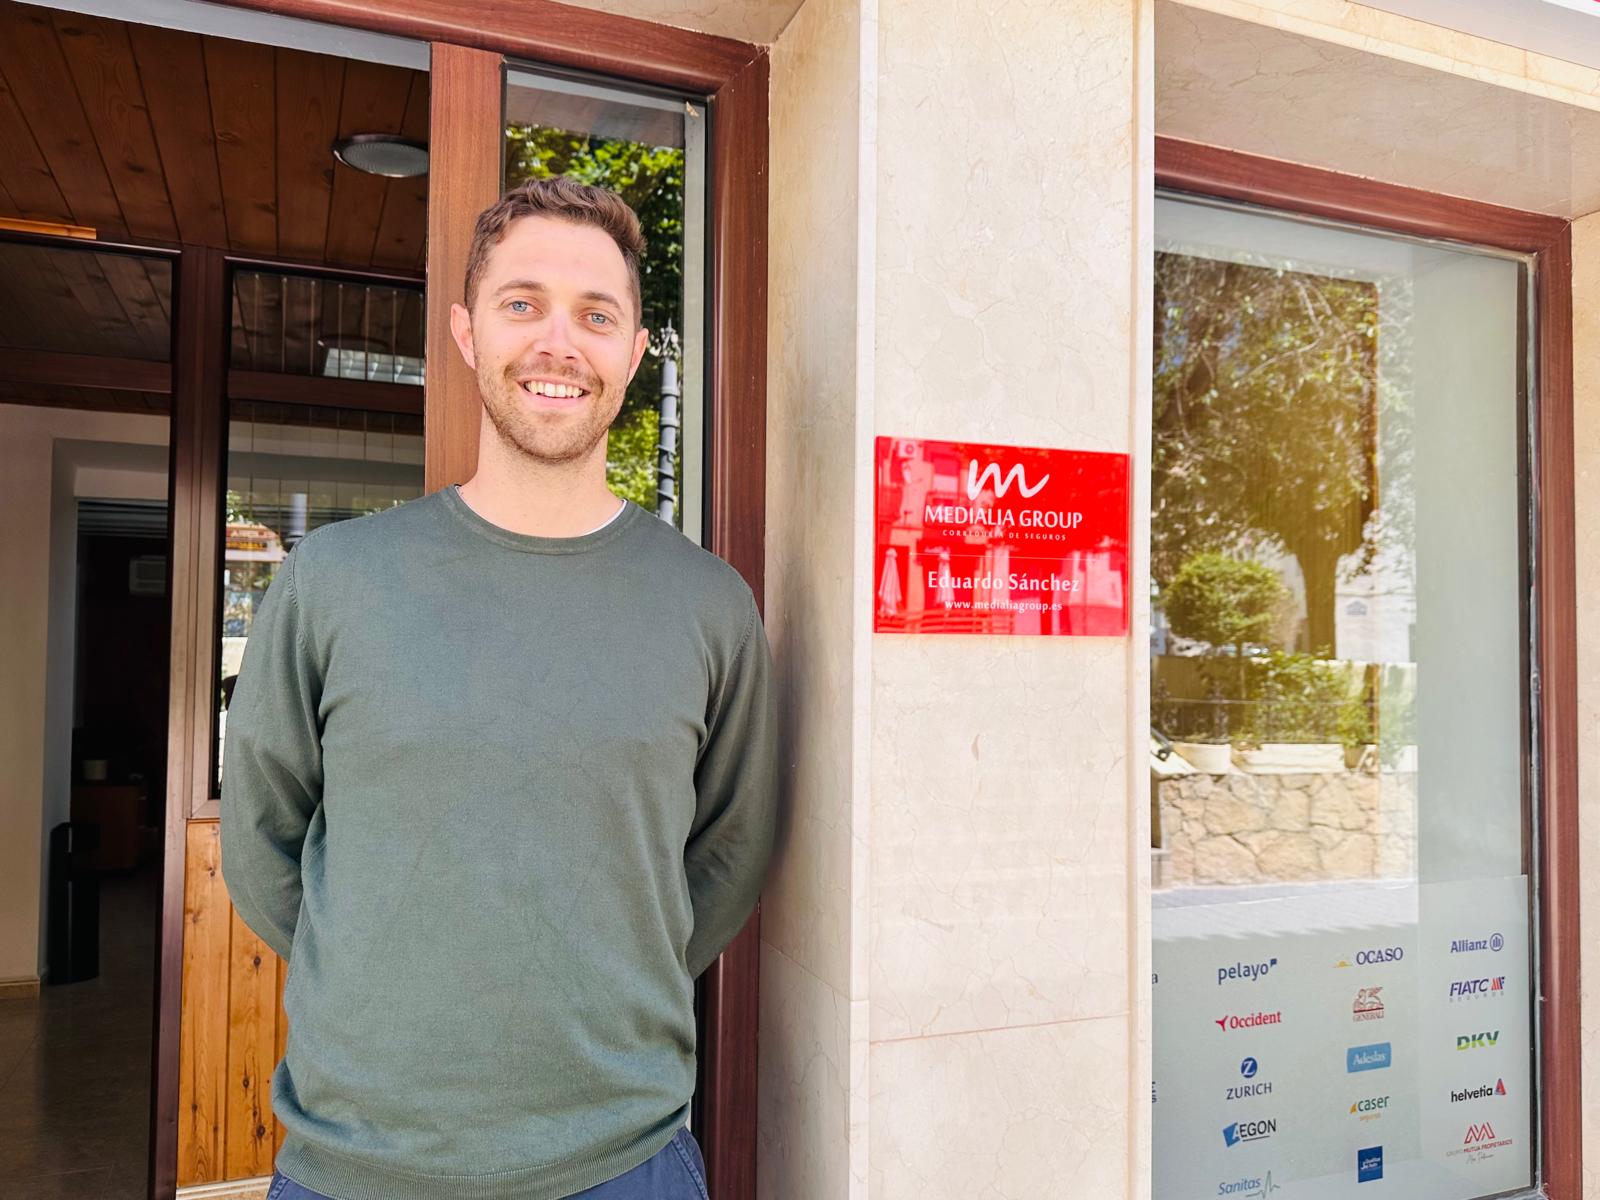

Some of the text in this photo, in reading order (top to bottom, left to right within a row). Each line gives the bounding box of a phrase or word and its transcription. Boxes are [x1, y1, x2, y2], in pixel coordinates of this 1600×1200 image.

[924, 505, 1083, 529] MEDIALIA GROUP
[1008, 532, 1020, 540] DE
[1024, 533, 1067, 541] SEGUROS
[928, 571, 1081, 592] Eduardo Sánchez
[944, 599, 1063, 614] www.medialiagroup.es
[1355, 946, 1404, 965] OCASO
[1450, 938, 1488, 954] Allianz
[1217, 962, 1269, 985] pelayo
[1449, 978, 1489, 997] FIATC
[1229, 1011, 1282, 1029] Occident
[1456, 1030, 1500, 1051] DKV
[1226, 1082, 1273, 1100] ZURICH
[1450, 1084, 1494, 1103] helvetia
[1357, 1095, 1391, 1112] caser
[1230, 1118, 1277, 1140] AEGON
[1217, 1177, 1262, 1196] Sanitas
